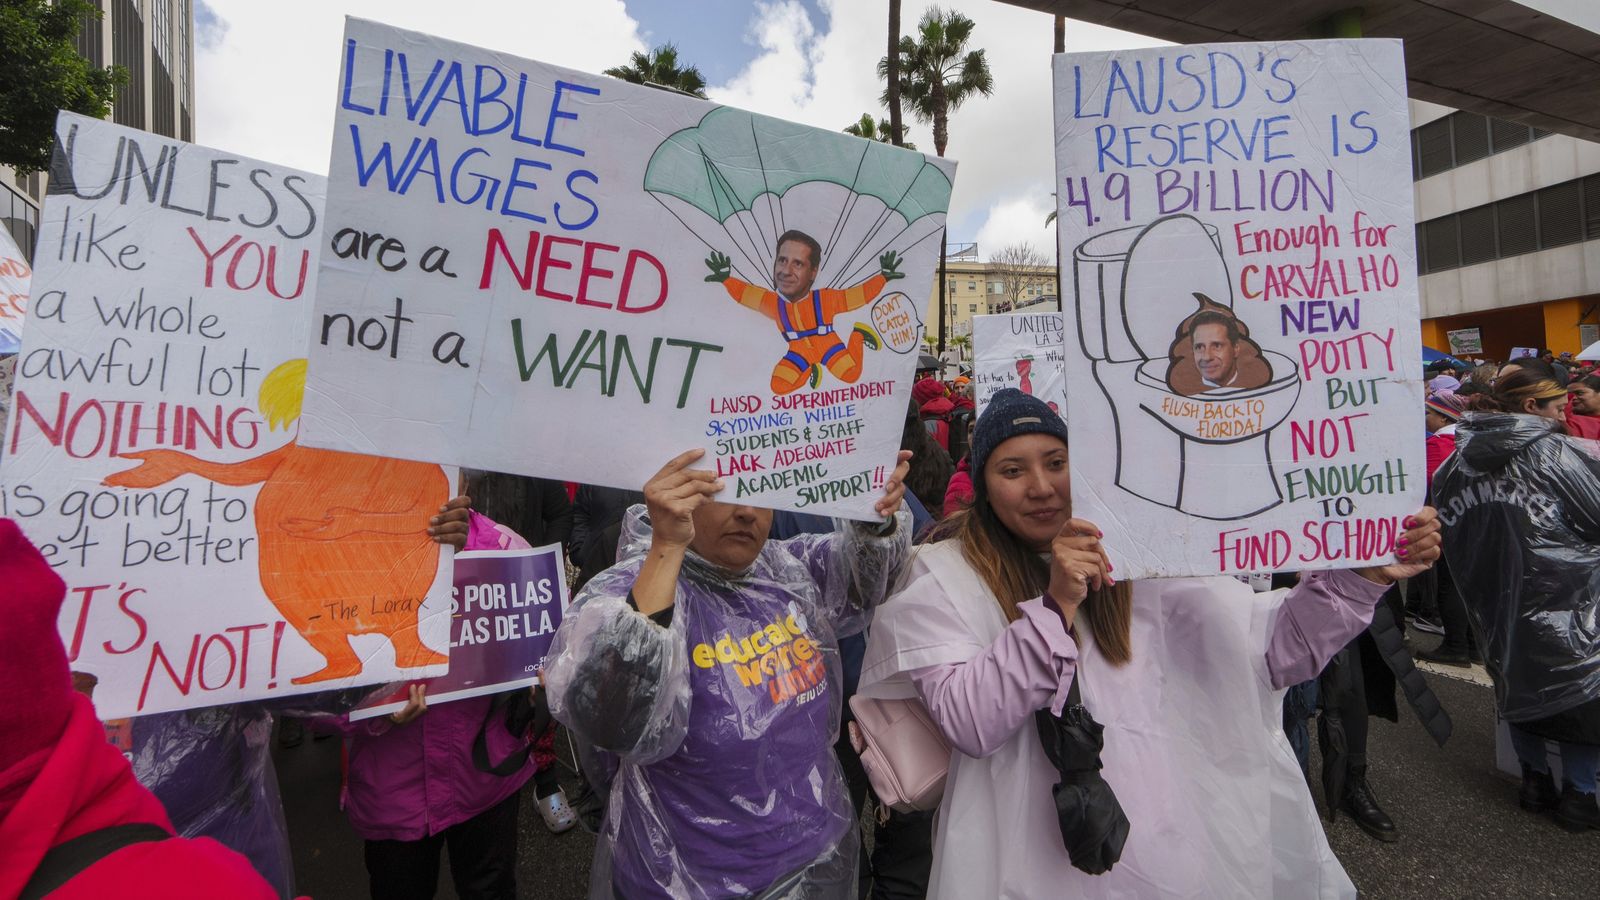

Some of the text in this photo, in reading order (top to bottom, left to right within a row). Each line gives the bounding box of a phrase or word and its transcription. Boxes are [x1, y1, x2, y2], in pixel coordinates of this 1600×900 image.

[342, 39, 600, 156] LIVABLE
[1074, 52, 1297, 119] LAUSD'S
[1095, 110, 1379, 172] RESERVE IS
[66, 123, 317, 239] UNLESS
[350, 124, 599, 231] WAGES
[1066, 168, 1335, 227] 4.9 BILLION
[59, 205, 309, 300] like YOU
[1234, 210, 1397, 270] Enough for
[331, 227, 668, 314] are a NEED
[1240, 254, 1399, 301] CARVALHO
[35, 290, 66, 323] a
[94, 287, 226, 339] whole
[879, 311, 909, 333] CATCH
[891, 325, 916, 346] HIM!
[1011, 316, 1063, 336] UNITED
[1280, 298, 1360, 336] NEW
[21, 337, 170, 392] awful
[197, 346, 260, 397] lot
[320, 297, 723, 409] not a WANT
[1299, 327, 1394, 381] POTTY
[710, 380, 896, 414] LAUSD SUPERINTENDENT
[1162, 397, 1265, 420] FLUSH BACK TO
[1326, 376, 1388, 410] BUT
[10, 390, 264, 458] NOTHING
[706, 404, 856, 437] SKYDIVING WHILE
[716, 418, 865, 456] STUDENTS & STAFF
[1196, 414, 1263, 438] FLORIDA!
[1290, 413, 1369, 463] NOT
[716, 437, 856, 478] LACK ADEQUATE
[736, 463, 828, 498] ACADEMIC
[795, 466, 884, 508] SUPPORT!!
[1284, 458, 1408, 503] ENOUGH
[1, 482, 248, 543] is going to
[1318, 496, 1356, 517] TO
[40, 522, 254, 568] et better
[1212, 527, 1292, 572] FUND
[371, 594, 430, 616] Lorax
[465, 583, 507, 613] POR
[511, 578, 553, 608] LAS
[69, 581, 148, 663] T'S
[495, 613, 521, 642] DE
[137, 620, 287, 712] NOT!
[796, 688, 816, 707] SEIU
